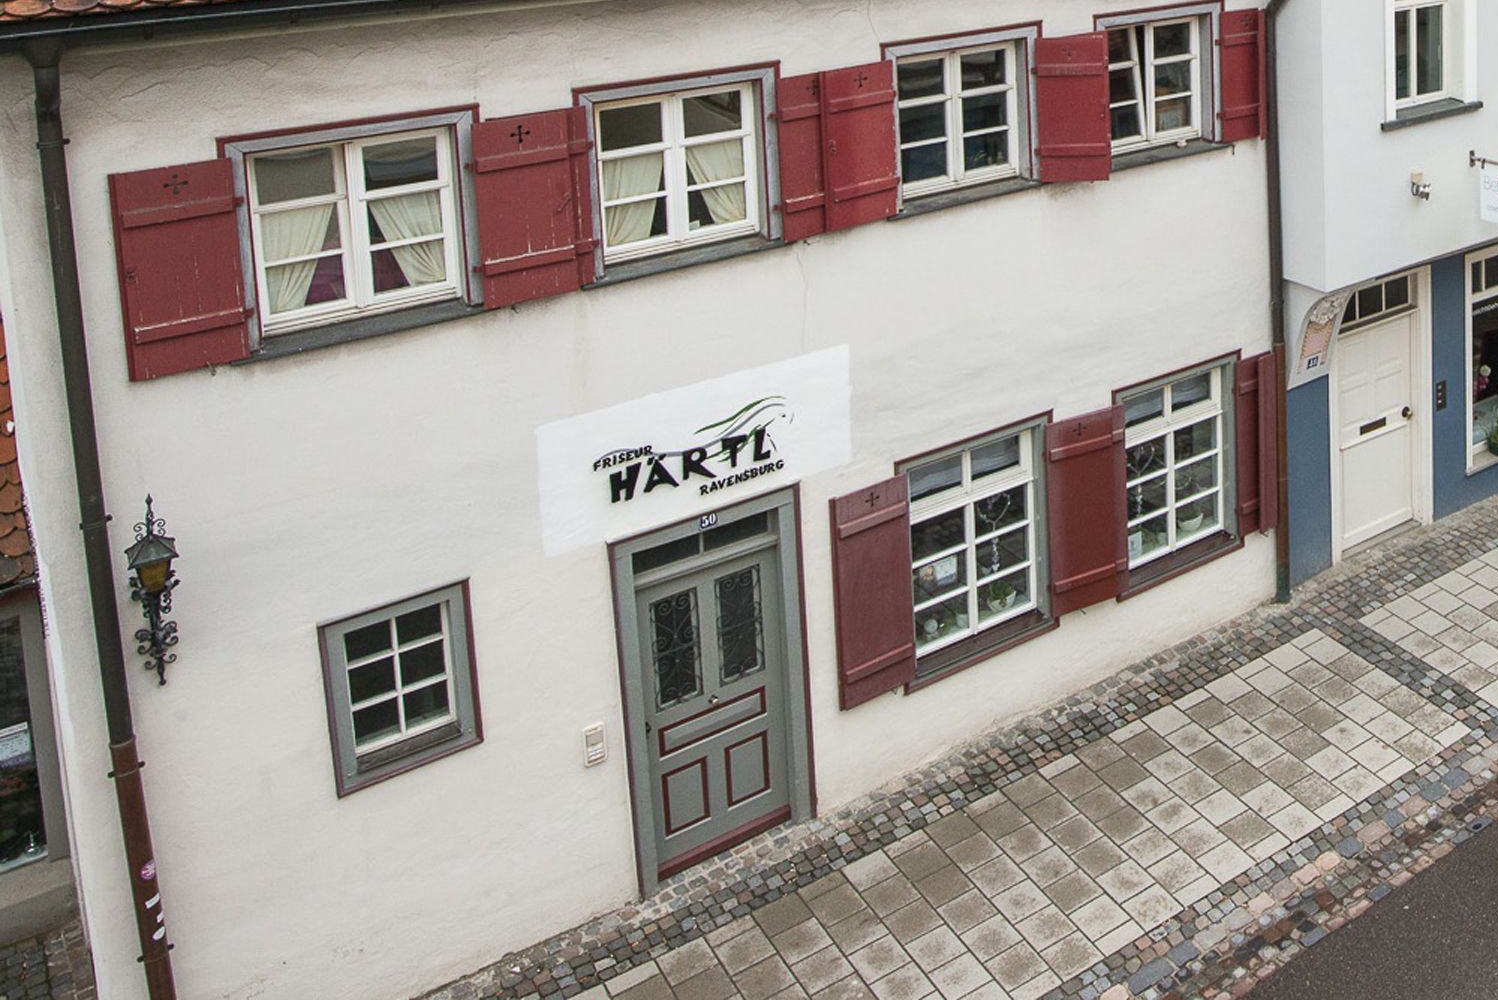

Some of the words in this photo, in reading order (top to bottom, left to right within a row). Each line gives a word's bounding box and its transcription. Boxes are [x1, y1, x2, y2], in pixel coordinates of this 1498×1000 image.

[593, 445, 652, 472] FRISEUR
[609, 427, 771, 503] HÄRTL
[700, 459, 785, 496] RAVENSBURG
[701, 513, 717, 528] 50
